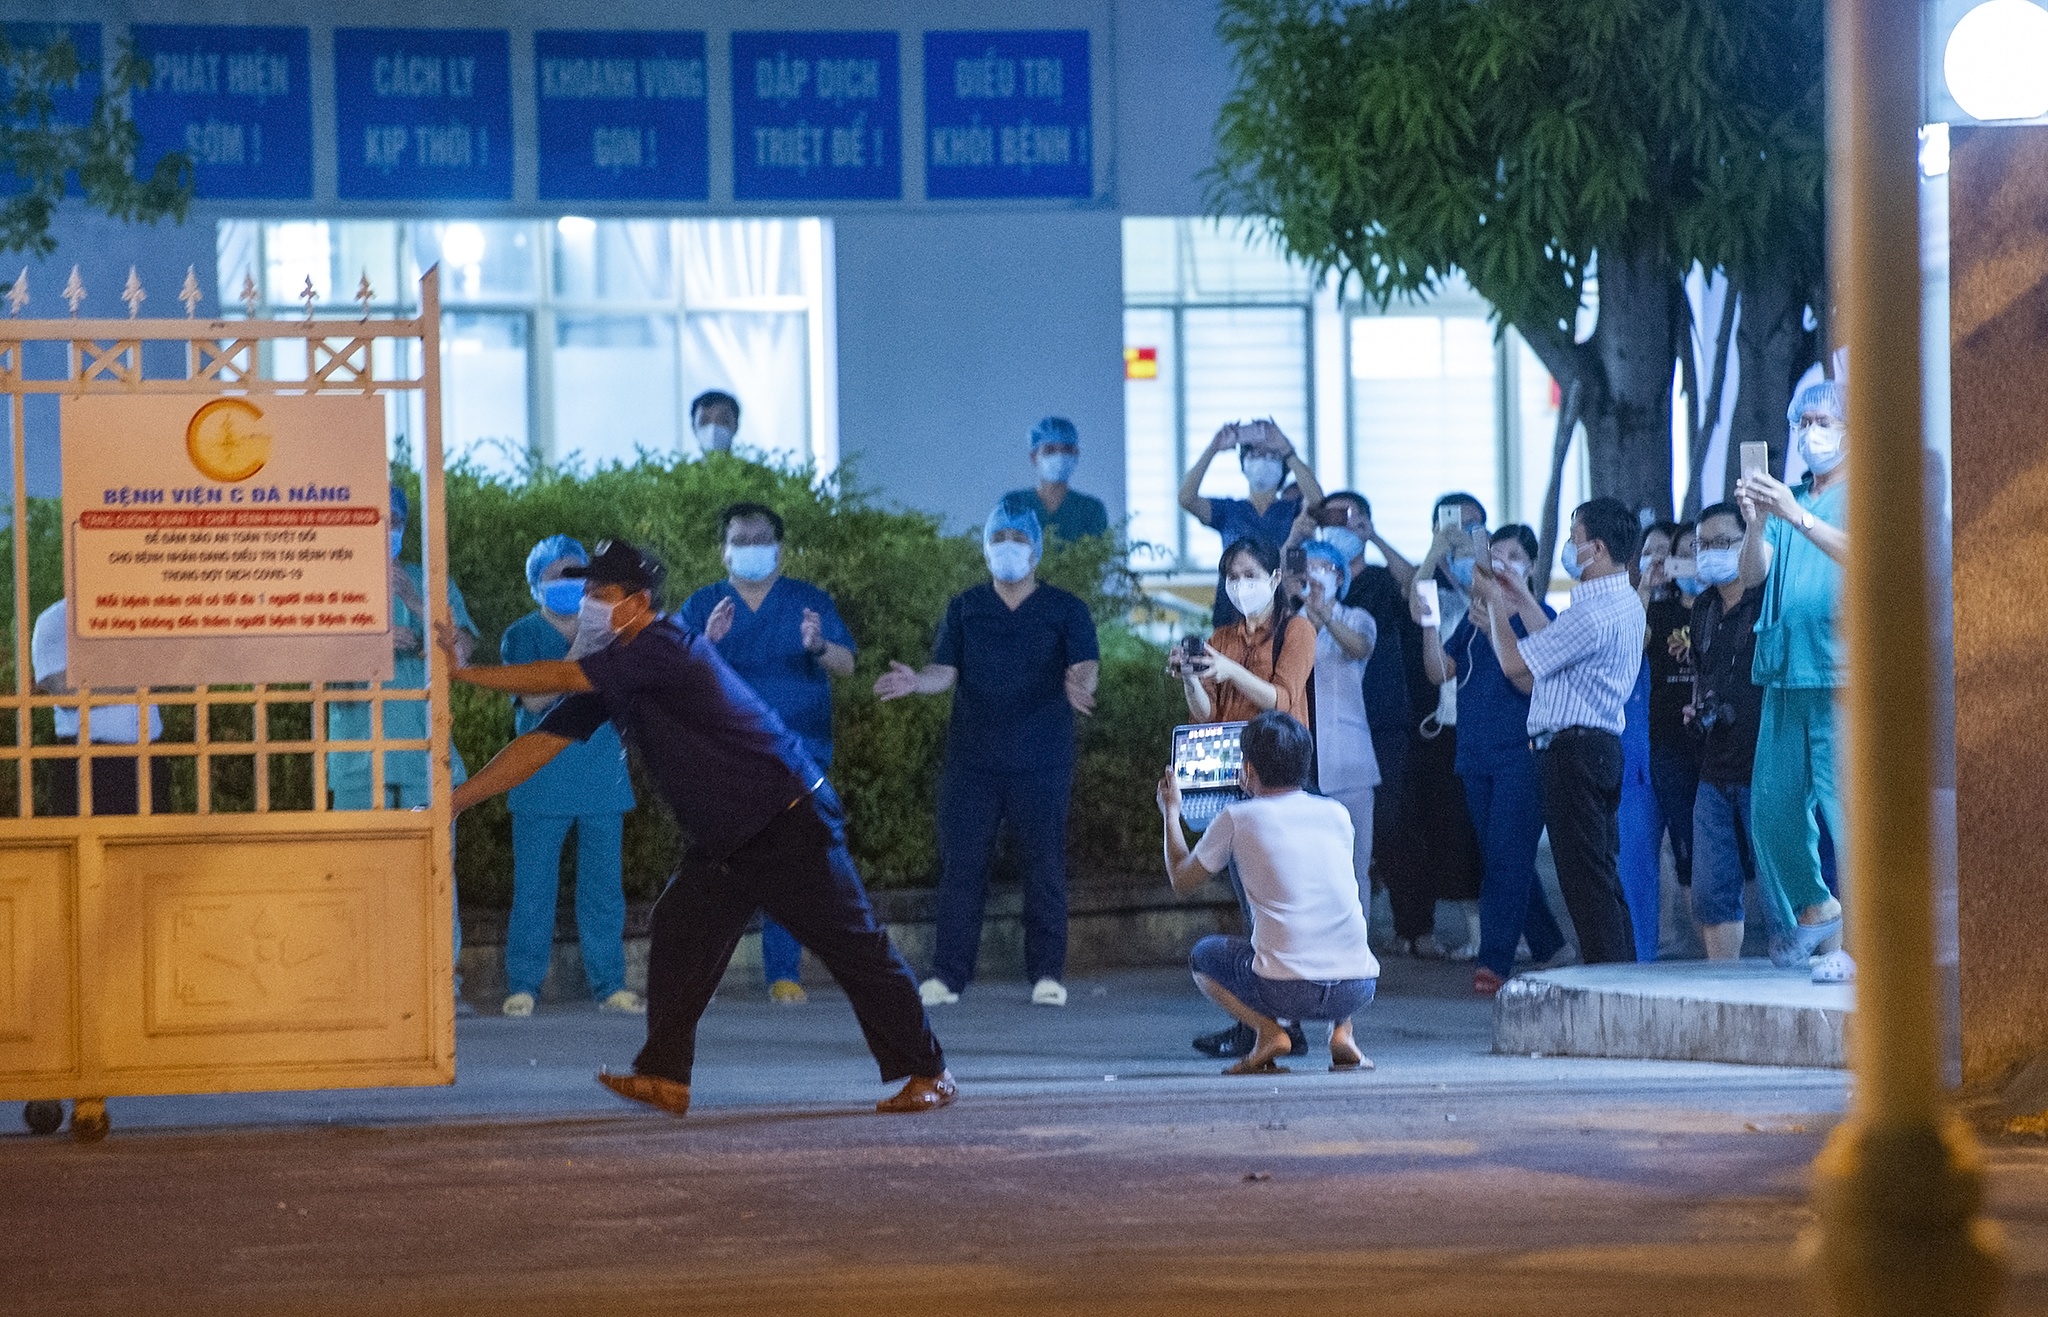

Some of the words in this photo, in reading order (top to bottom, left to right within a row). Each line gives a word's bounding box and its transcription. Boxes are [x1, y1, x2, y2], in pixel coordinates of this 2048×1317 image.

[153, 46, 220, 93] PHÁT
[227, 48, 289, 105] HIỆN
[373, 51, 441, 97] CÁCH
[542, 58, 635, 97] KHOANH
[641, 51, 704, 97] VÙNG
[1023, 59, 1063, 105] TRỊ
[365, 127, 406, 174] KỊP
[417, 115, 472, 166] THỜI
[755, 120, 823, 177] TRIỆT
[1000, 118, 1070, 175] BỆNH
[103, 486, 164, 507] BỆNH
[172, 486, 222, 507] VIỆN
[230, 488, 244, 503] C
[252, 484, 280, 502] ĐÀ
